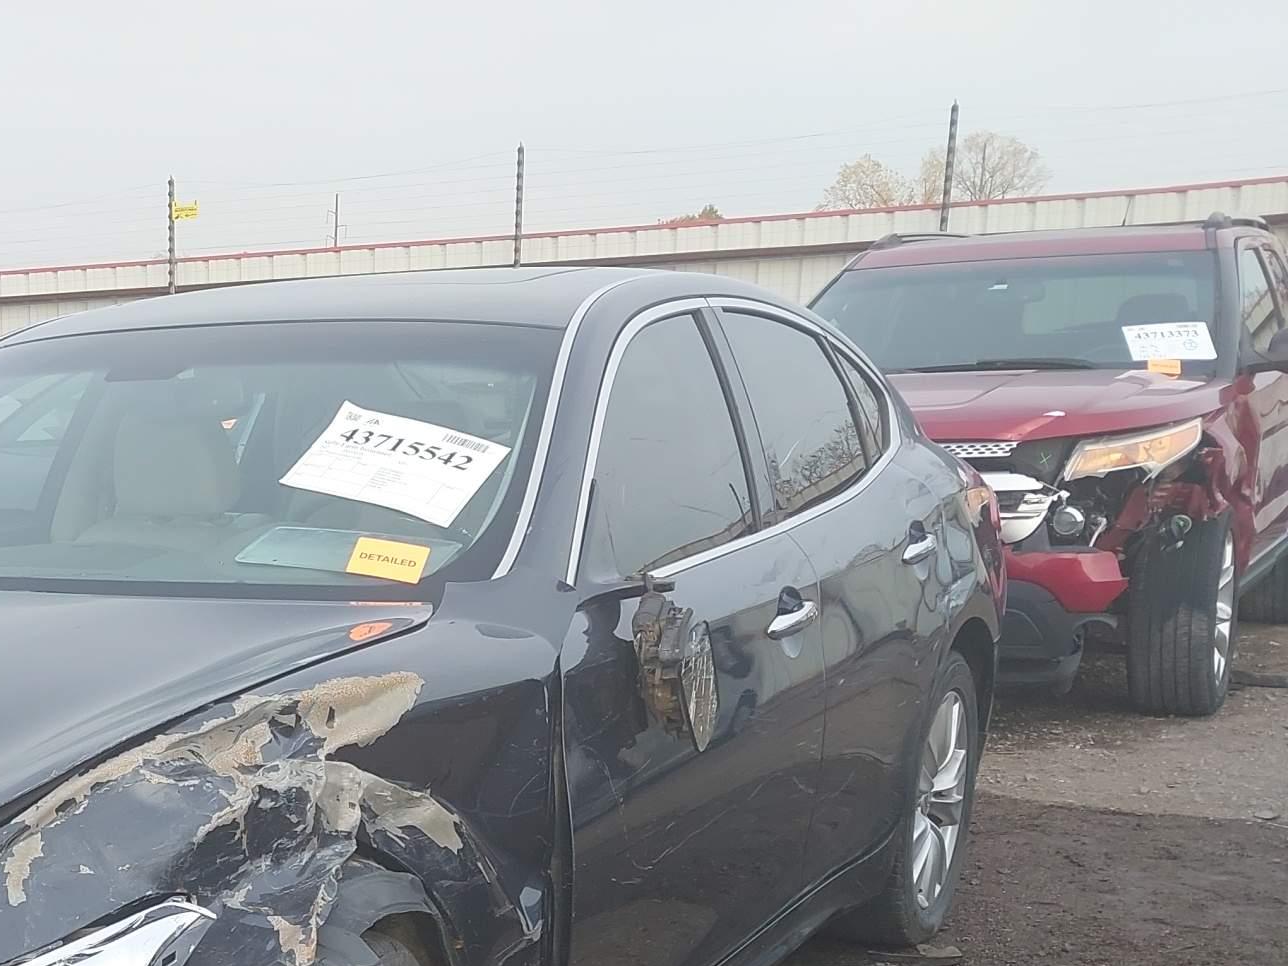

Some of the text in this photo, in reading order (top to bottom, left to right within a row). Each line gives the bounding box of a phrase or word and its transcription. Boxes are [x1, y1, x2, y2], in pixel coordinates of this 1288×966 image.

[1134, 329, 1200, 340] 43713373
[340, 428, 474, 471] 43715542
[359, 551, 417, 568] DETAILED
